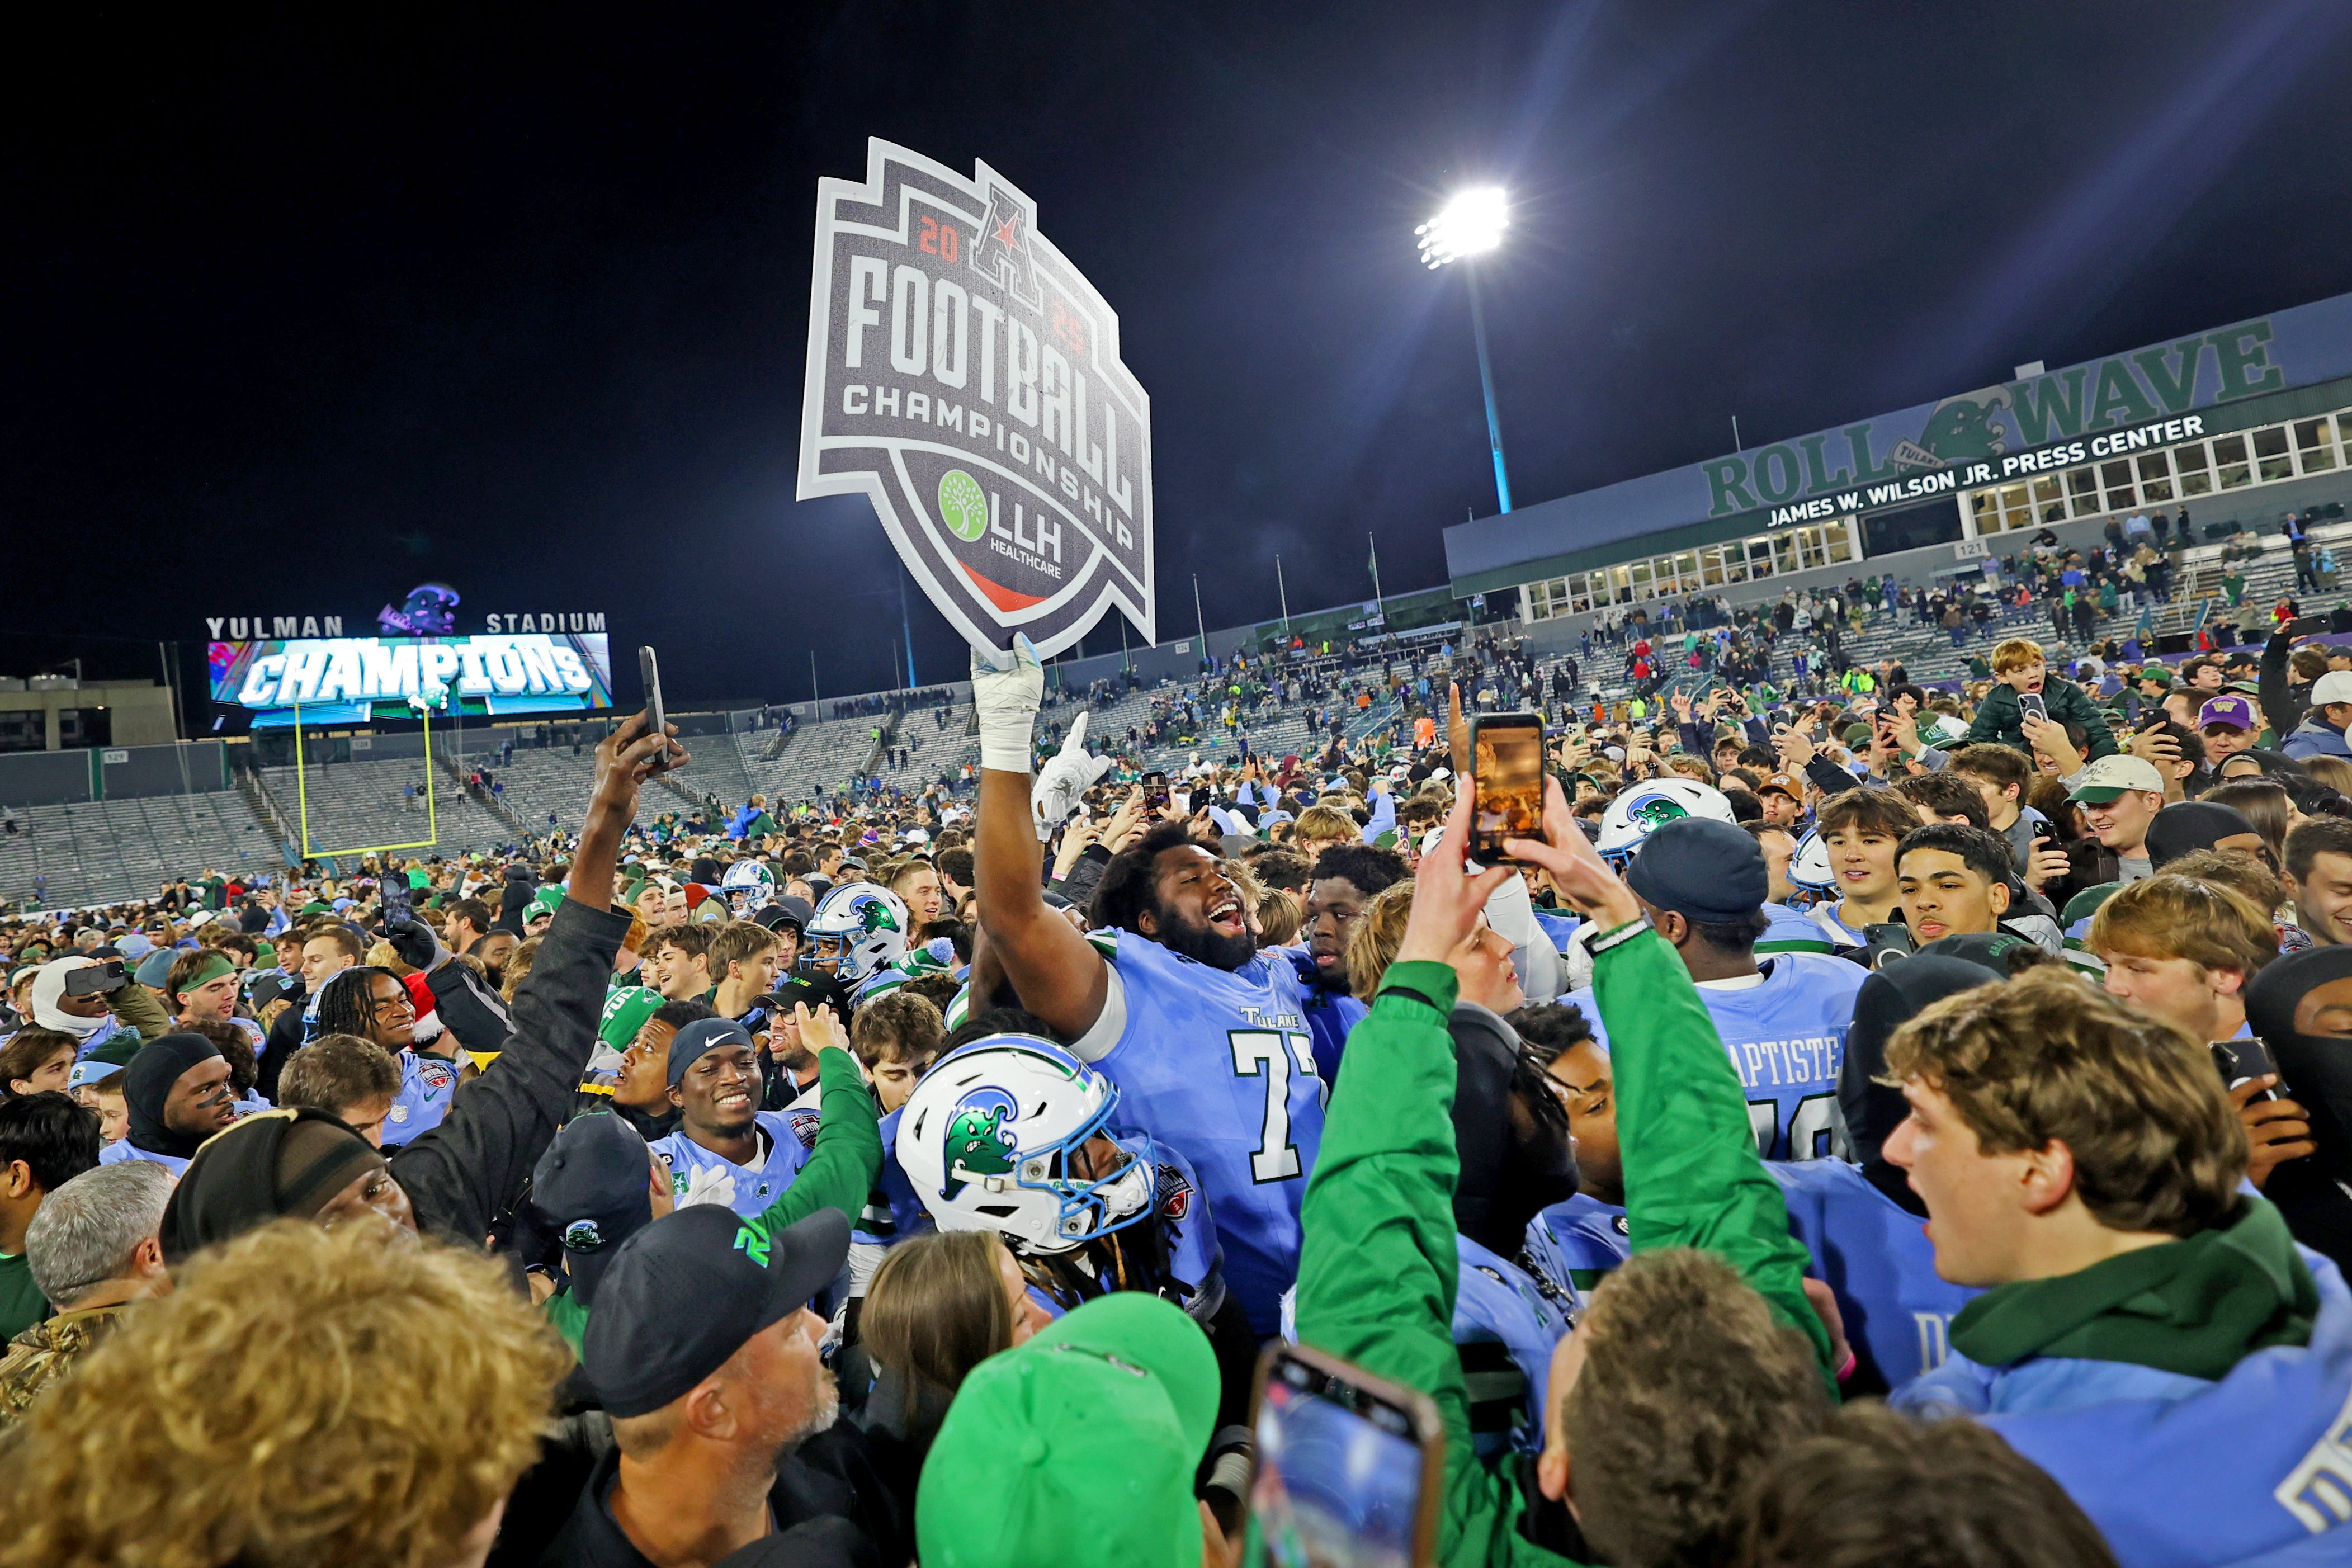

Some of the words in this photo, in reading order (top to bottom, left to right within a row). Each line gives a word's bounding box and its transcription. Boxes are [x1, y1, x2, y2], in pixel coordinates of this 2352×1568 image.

[920, 215, 958, 263] 20
[846, 255, 1132, 521] FOOTBALL
[1702, 423, 1897, 517] ROLL
[2015, 320, 2284, 446] WAVE
[843, 385, 1134, 551] CHAMPIONSHIP
[1767, 498, 1833, 528] JAMES
[1836, 491, 1864, 512] W.
[1867, 470, 1956, 503] WILSON
[1962, 462, 1999, 486] JR.
[2002, 442, 2083, 478] PRESS
[2090, 415, 2204, 457] CENTER
[990, 492, 1061, 564] LLH
[1961, 543, 1982, 555] 121
[990, 537, 1061, 579] HEALTHCARE
[206, 616, 343, 640] YULMAN
[487, 613, 606, 634] STADIUM
[238, 644, 593, 708] CHAMPIONS
[2212, 701, 2237, 712] W
[1240, 1006, 1299, 1028] TULANE
[1728, 1036, 1840, 1087] APTISTE
